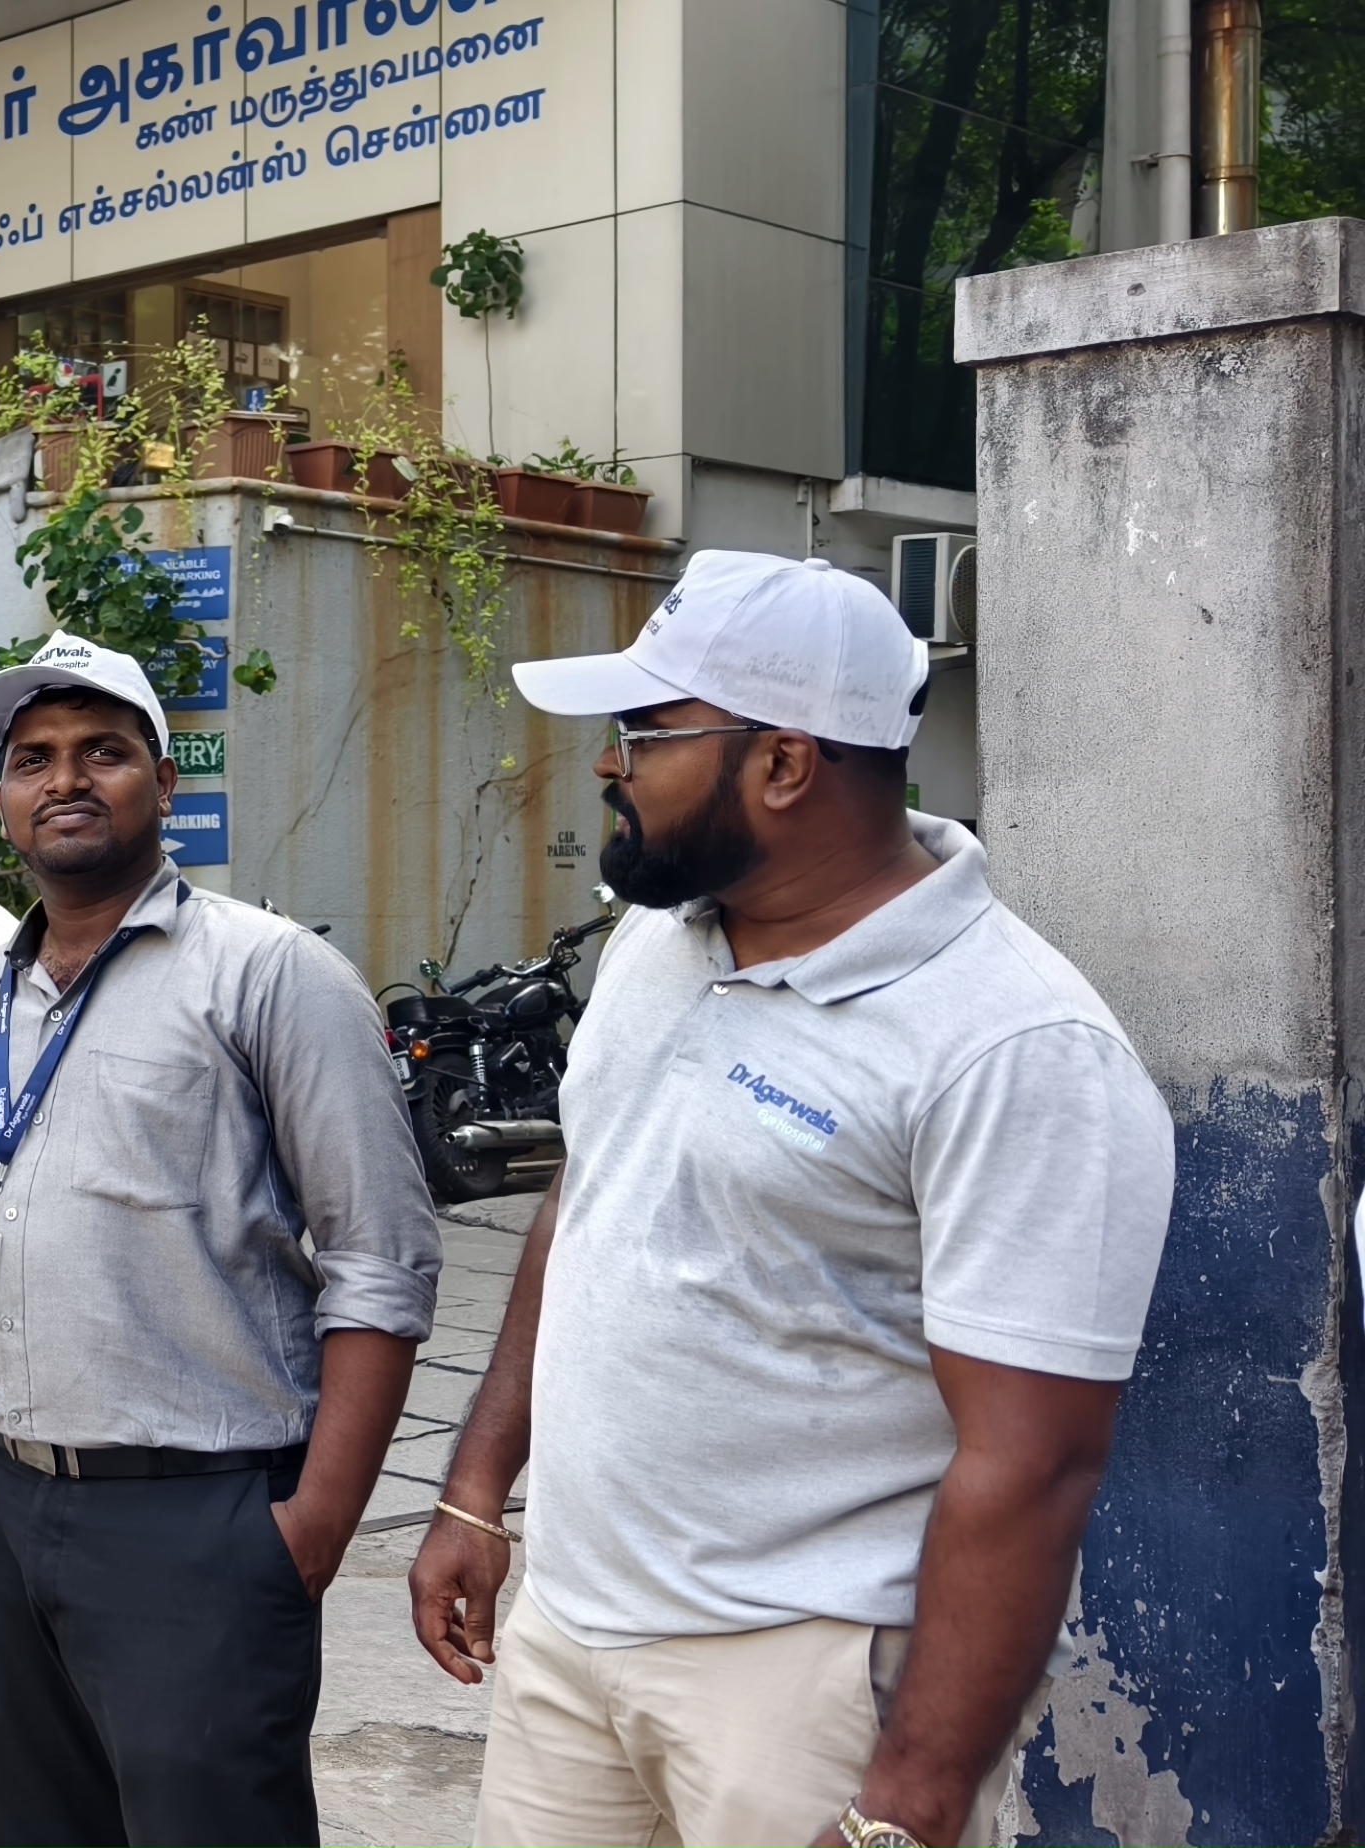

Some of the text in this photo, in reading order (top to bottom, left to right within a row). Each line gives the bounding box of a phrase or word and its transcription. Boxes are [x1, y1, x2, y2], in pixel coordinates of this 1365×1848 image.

[136, 16, 544, 150] கண் மருத்துவமனை
[58, 140, 306, 234] எக்சல்லன்ஸ்
[325, 88, 546, 167] சென்னை
[171, 740, 220, 767] TRY
[162, 814, 221, 830] PARKING
[547, 844, 586, 857] PARKING
[3, 1127, 13, 1138] Dr
[9, 1092, 31, 1129] Agarwals
[727, 1063, 839, 1135] Dr Agarwals
[757, 1108, 827, 1152] Eye Hospital
